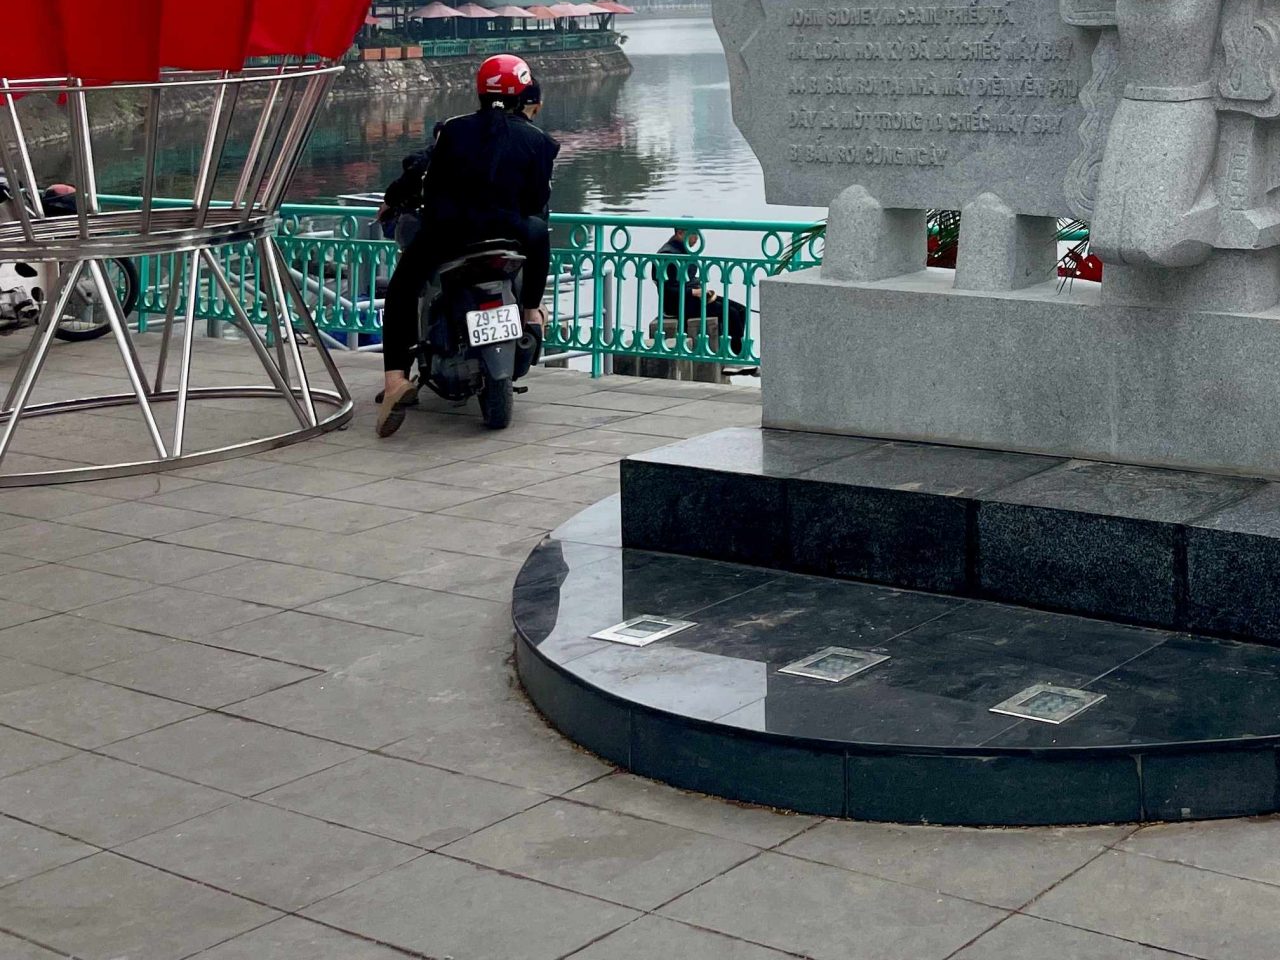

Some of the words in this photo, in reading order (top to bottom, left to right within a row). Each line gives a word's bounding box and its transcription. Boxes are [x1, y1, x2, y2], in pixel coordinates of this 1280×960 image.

[787, 7, 823, 27] JOHN
[827, 6, 880, 27] SIDNEY
[854, 42, 883, 61] HOA
[1041, 41, 1075, 61] BAY
[874, 110, 923, 131] TRONG
[472, 322, 519, 344] 952.30
